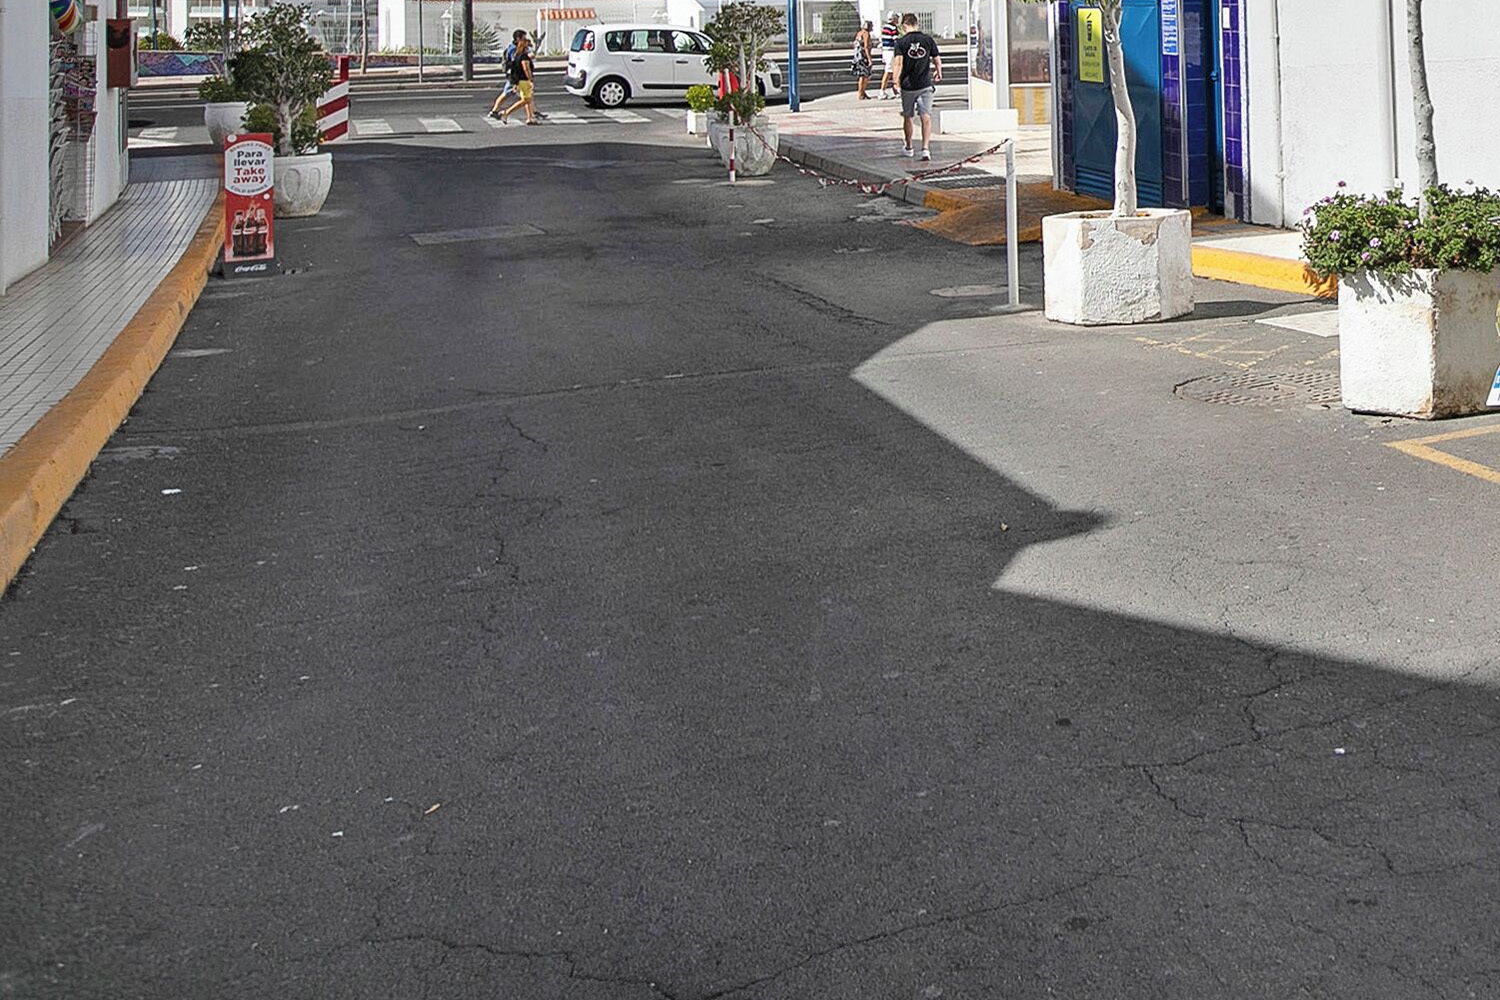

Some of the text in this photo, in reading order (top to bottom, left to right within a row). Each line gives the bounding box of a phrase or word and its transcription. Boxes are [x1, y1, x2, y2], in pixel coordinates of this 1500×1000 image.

[237, 150, 263, 158] Para
[234, 159, 266, 167] llevar
[234, 167, 265, 176] Take
[233, 175, 266, 184] away
